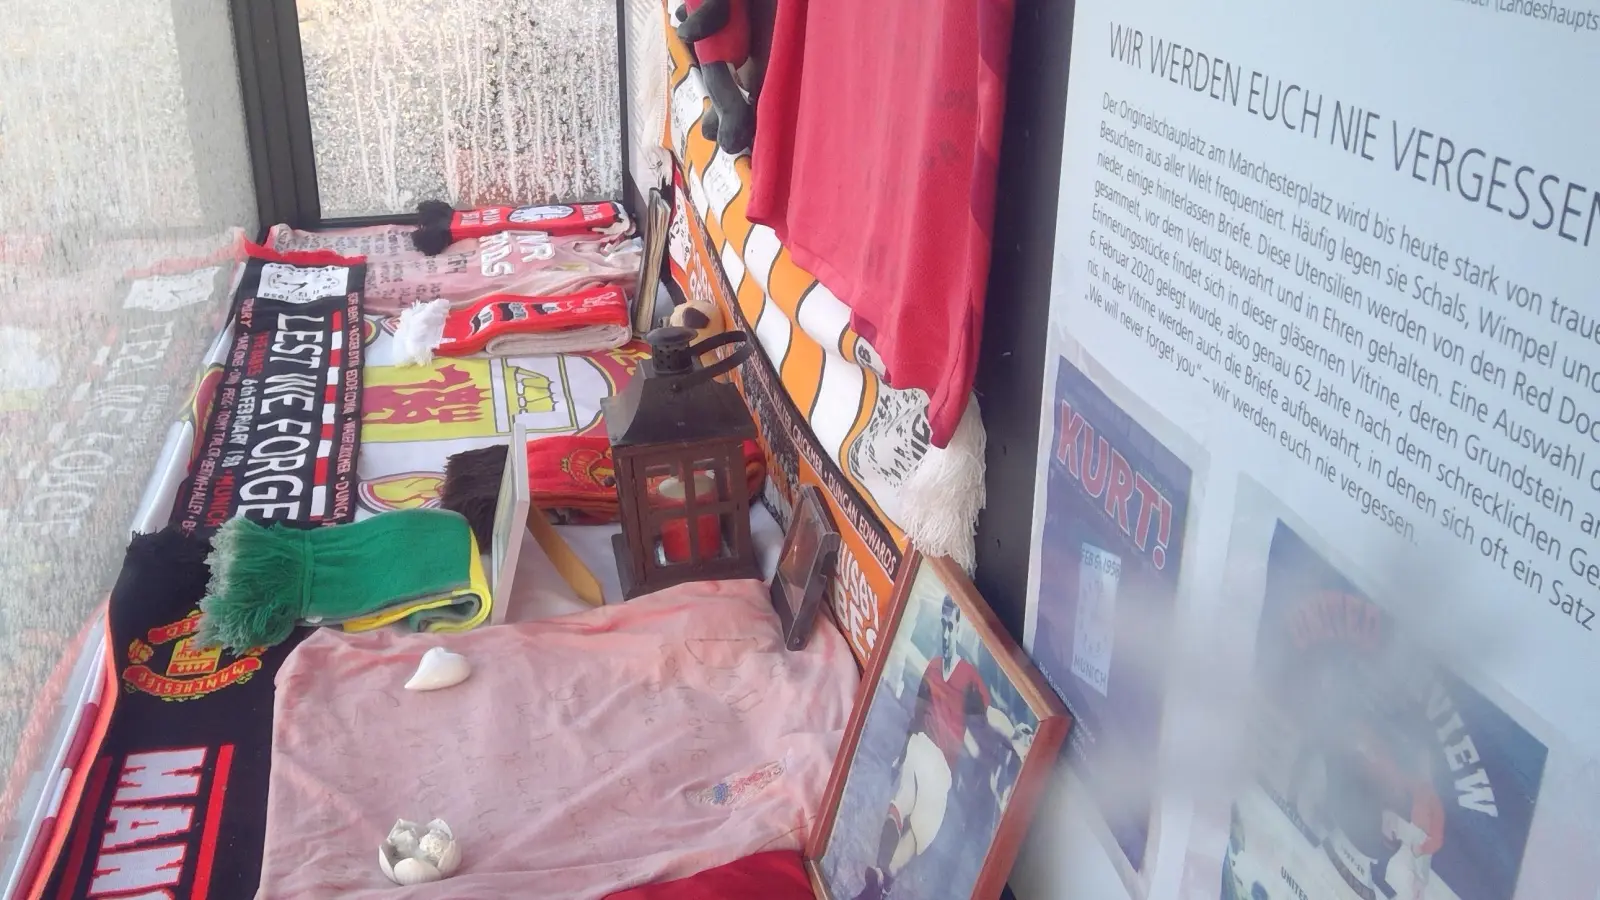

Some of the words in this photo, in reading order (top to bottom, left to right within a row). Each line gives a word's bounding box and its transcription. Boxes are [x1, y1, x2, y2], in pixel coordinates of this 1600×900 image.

[1110, 21, 1144, 68] WIR
[1150, 36, 1241, 106] WERDEN
[1248, 71, 1322, 138] EUCH
[1330, 100, 1380, 161] NIE
[1494, 0, 1600, 32] (Landeshaupts
[1100, 120, 1144, 158] Besuchern
[1146, 147, 1162, 167] aus
[1164, 153, 1184, 178] aller
[1188, 162, 1212, 194] Welt
[1215, 176, 1286, 231] frequentiert.
[1292, 214, 1336, 262] Häufig
[1340, 237, 1381, 280] legen
[1386, 264, 1407, 292] sie
[1412, 275, 1469, 330] Schals,
[1480, 306, 1557, 368] Wimpel
[1102, 92, 1118, 115] Der
[1120, 100, 1206, 156] Originalschauplatz
[1208, 145, 1226, 165] am
[1228, 149, 1333, 215] Manchesterplatz
[1336, 202, 1370, 232] wird
[1373, 212, 1396, 245] bis
[1400, 224, 1448, 270] heute
[1452, 257, 1499, 295] stark
[1506, 280, 1542, 315] von
[269, 312, 324, 369] LEST
[1095, 180, 1142, 222] gesammelt,
[1145, 208, 1160, 228] vor
[1162, 216, 1184, 244] dem
[1188, 228, 1222, 266] Verlust
[1225, 250, 1274, 297] bewahrt
[1277, 285, 1303, 313] und
[1306, 296, 1318, 322] in
[1323, 307, 1363, 350] Ehren
[1368, 339, 1442, 397] gehalten.
[1450, 380, 1488, 423] Eine
[1493, 409, 1585, 480] Auswahl
[1097, 152, 1124, 182] nieder,
[1127, 166, 1154, 196] einige
[1156, 178, 1215, 228] hinterlassen
[1218, 213, 1252, 249] Briefe.
[1258, 234, 1290, 270] Diese
[1295, 254, 1362, 309] Utensilien
[1368, 297, 1426, 345] werden
[1434, 332, 1464, 366] von
[1470, 350, 1506, 390] den
[1512, 371, 1553, 414] Red
[260, 372, 318, 415] WE
[1092, 202, 1170, 266] Erinnerungsstücke
[1173, 251, 1202, 287] findet
[1204, 274, 1224, 300] sich
[1228, 286, 1238, 310] in
[1242, 296, 1278, 332] dieser
[1280, 322, 1345, 377] gläsernen
[1351, 360, 1402, 417] Vitrine,
[1410, 401, 1458, 448] deren
[1465, 434, 1574, 522] Grundstein
[1099, 236, 1129, 269] Februar
[1131, 257, 1154, 286] 2020
[1156, 277, 1186, 309] gelegt
[1188, 299, 1224, 336] wurde,
[1228, 323, 1250, 350] also
[1252, 342, 1290, 378] genau
[1294, 364, 1311, 392] 62
[1314, 378, 1351, 419] Jahre
[1355, 408, 1391, 446] nach
[1396, 432, 1432, 472] dem
[1436, 463, 1561, 561] schrecklichen
[1104, 299, 1118, 320] will
[1120, 311, 1144, 337] never
[1146, 325, 1175, 363] forget
[1212, 378, 1230, 403] wir
[1233, 393, 1276, 439] werden
[1280, 430, 1311, 466] euch
[1315, 456, 1336, 484] nie
[1340, 473, 1419, 547] vergessen.
[204, 476, 235, 528] MUNICH
[332, 481, 349, 520] DUNCA
[792, 424, 824, 478] CRICKMER
[828, 472, 858, 524] DUNCAN
[858, 515, 897, 576] EDWARDS
[1057, 399, 1172, 570] KURT!
[1102, 266, 1110, 284] In
[1112, 274, 1126, 296] der
[1128, 283, 1156, 318] Vitrine
[1158, 308, 1194, 344] werden
[1196, 336, 1222, 364] auch
[1224, 352, 1241, 378] die
[1245, 364, 1278, 404] Briefe
[1282, 396, 1362, 468] aufbewahrt,
[1368, 450, 1382, 479] in
[1386, 466, 1436, 518] denen
[1440, 506, 1475, 545] sich
[1481, 536, 1508, 570] oft
[1513, 559, 1543, 594] ein
[1549, 579, 1595, 631] Satz
[836, 540, 879, 631] USBY
[137, 664, 245, 696] MANCHESTER
[1074, 654, 1106, 684] MUNICH
[84, 747, 208, 900] MAN
[1426, 682, 1498, 817] VIEW
